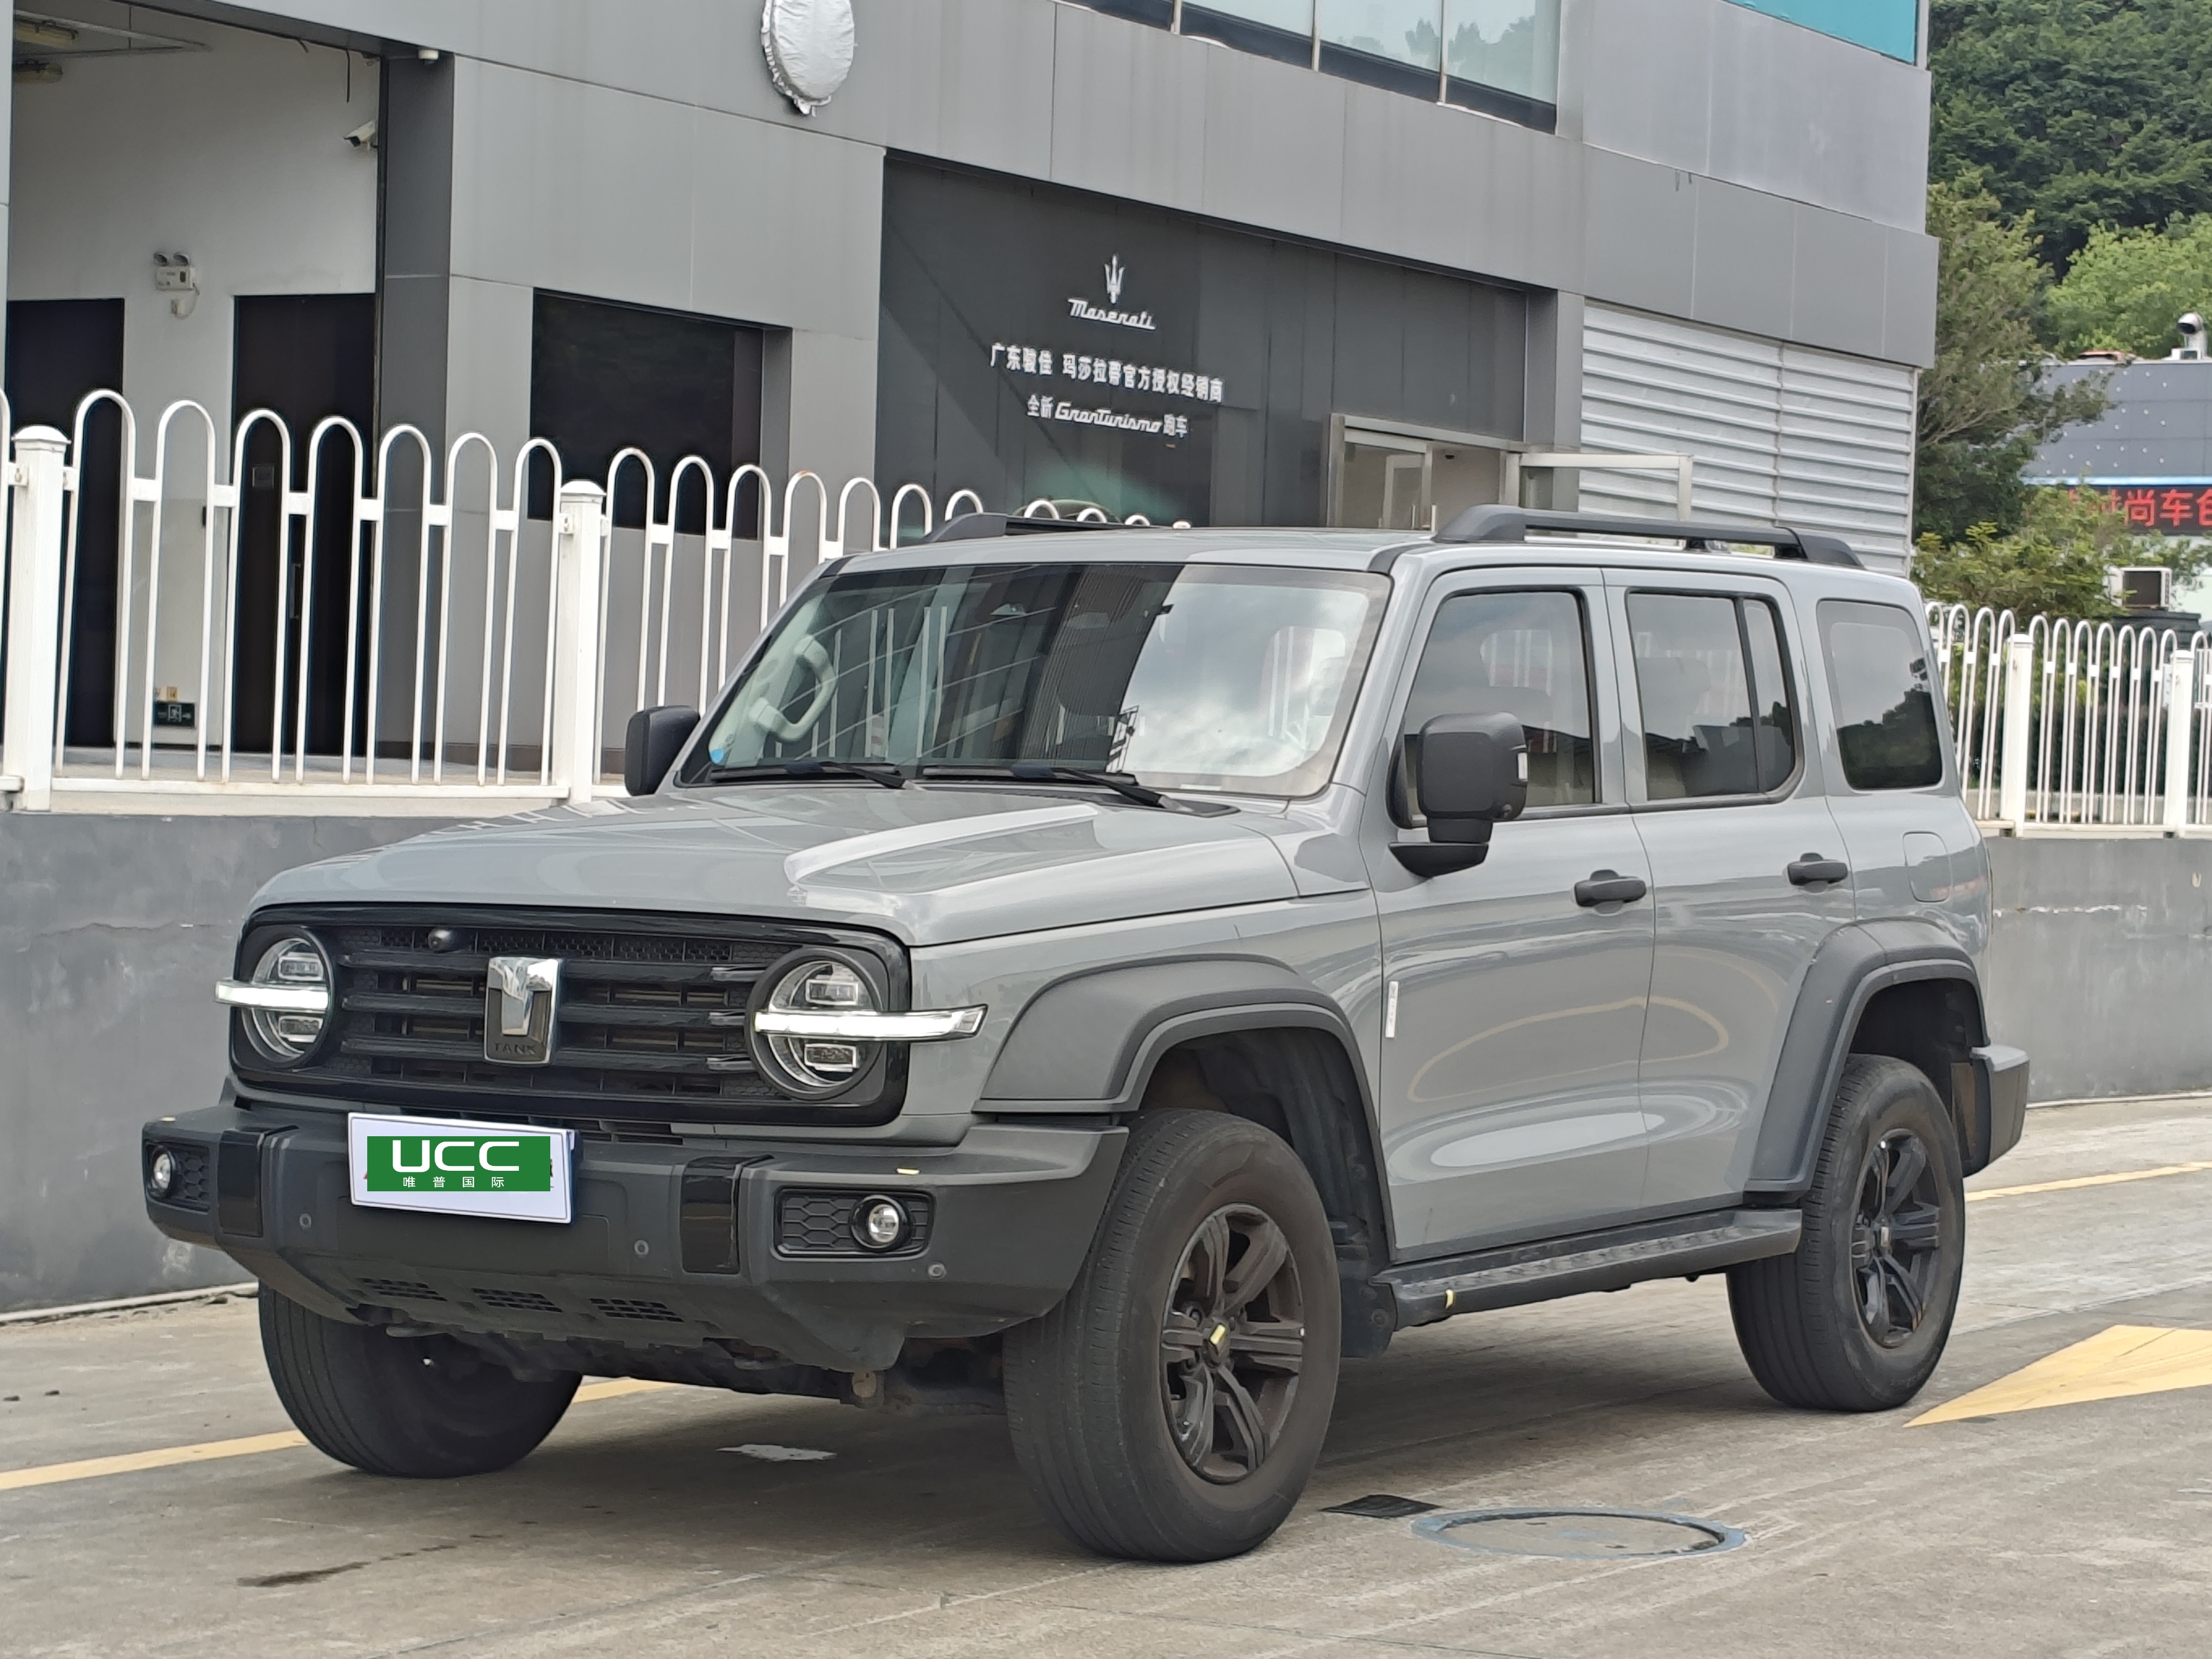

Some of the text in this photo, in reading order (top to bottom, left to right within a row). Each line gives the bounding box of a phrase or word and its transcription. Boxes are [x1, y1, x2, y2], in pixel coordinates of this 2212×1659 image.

[1068, 298, 1156, 331] Maserati
[1062, 353, 1224, 403] 玛莎拉蒂官方授权经销商
[1027, 394, 1054, 419] 全新
[1055, 401, 1162, 433] GranTurismo
[494, 1042, 536, 1055] TANK
